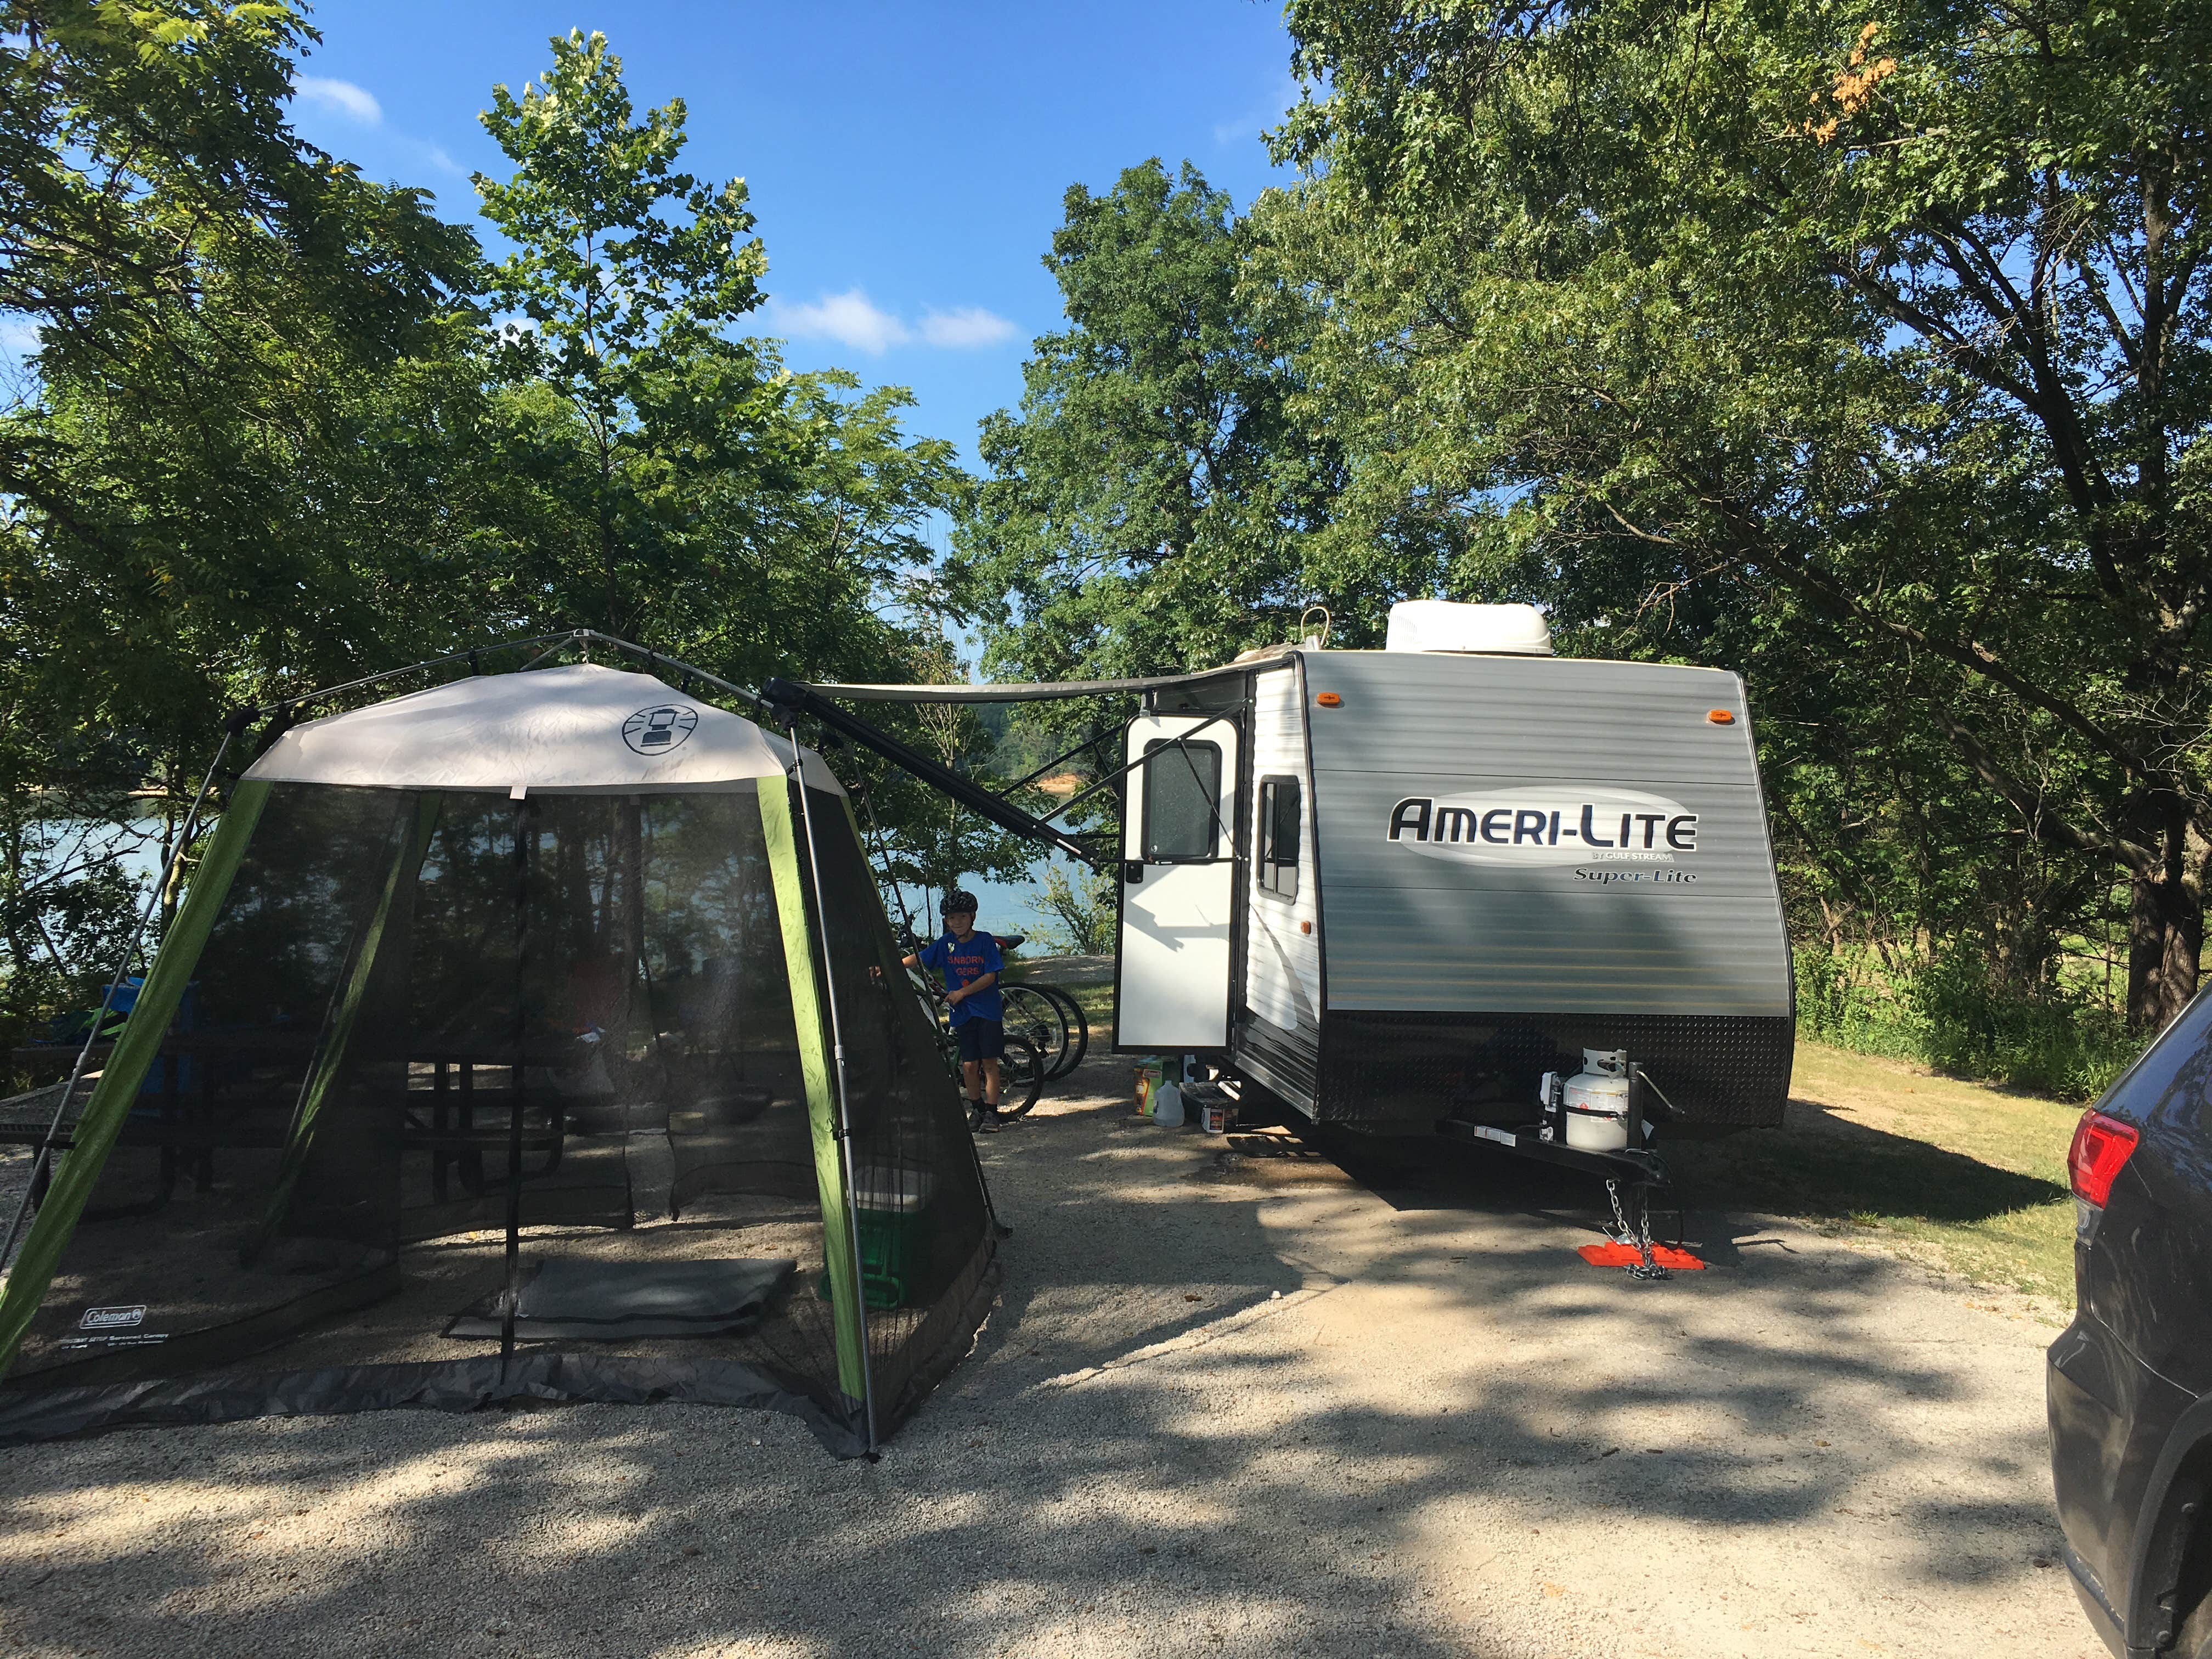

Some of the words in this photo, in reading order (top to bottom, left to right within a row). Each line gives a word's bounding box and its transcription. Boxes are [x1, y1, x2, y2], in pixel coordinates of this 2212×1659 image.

[1606, 852, 1630, 860] GULF
[1632, 852, 1673, 862] STREAM
[1574, 868, 1697, 885] Super-Lite
[87, 1311, 131, 1323] Coleman
